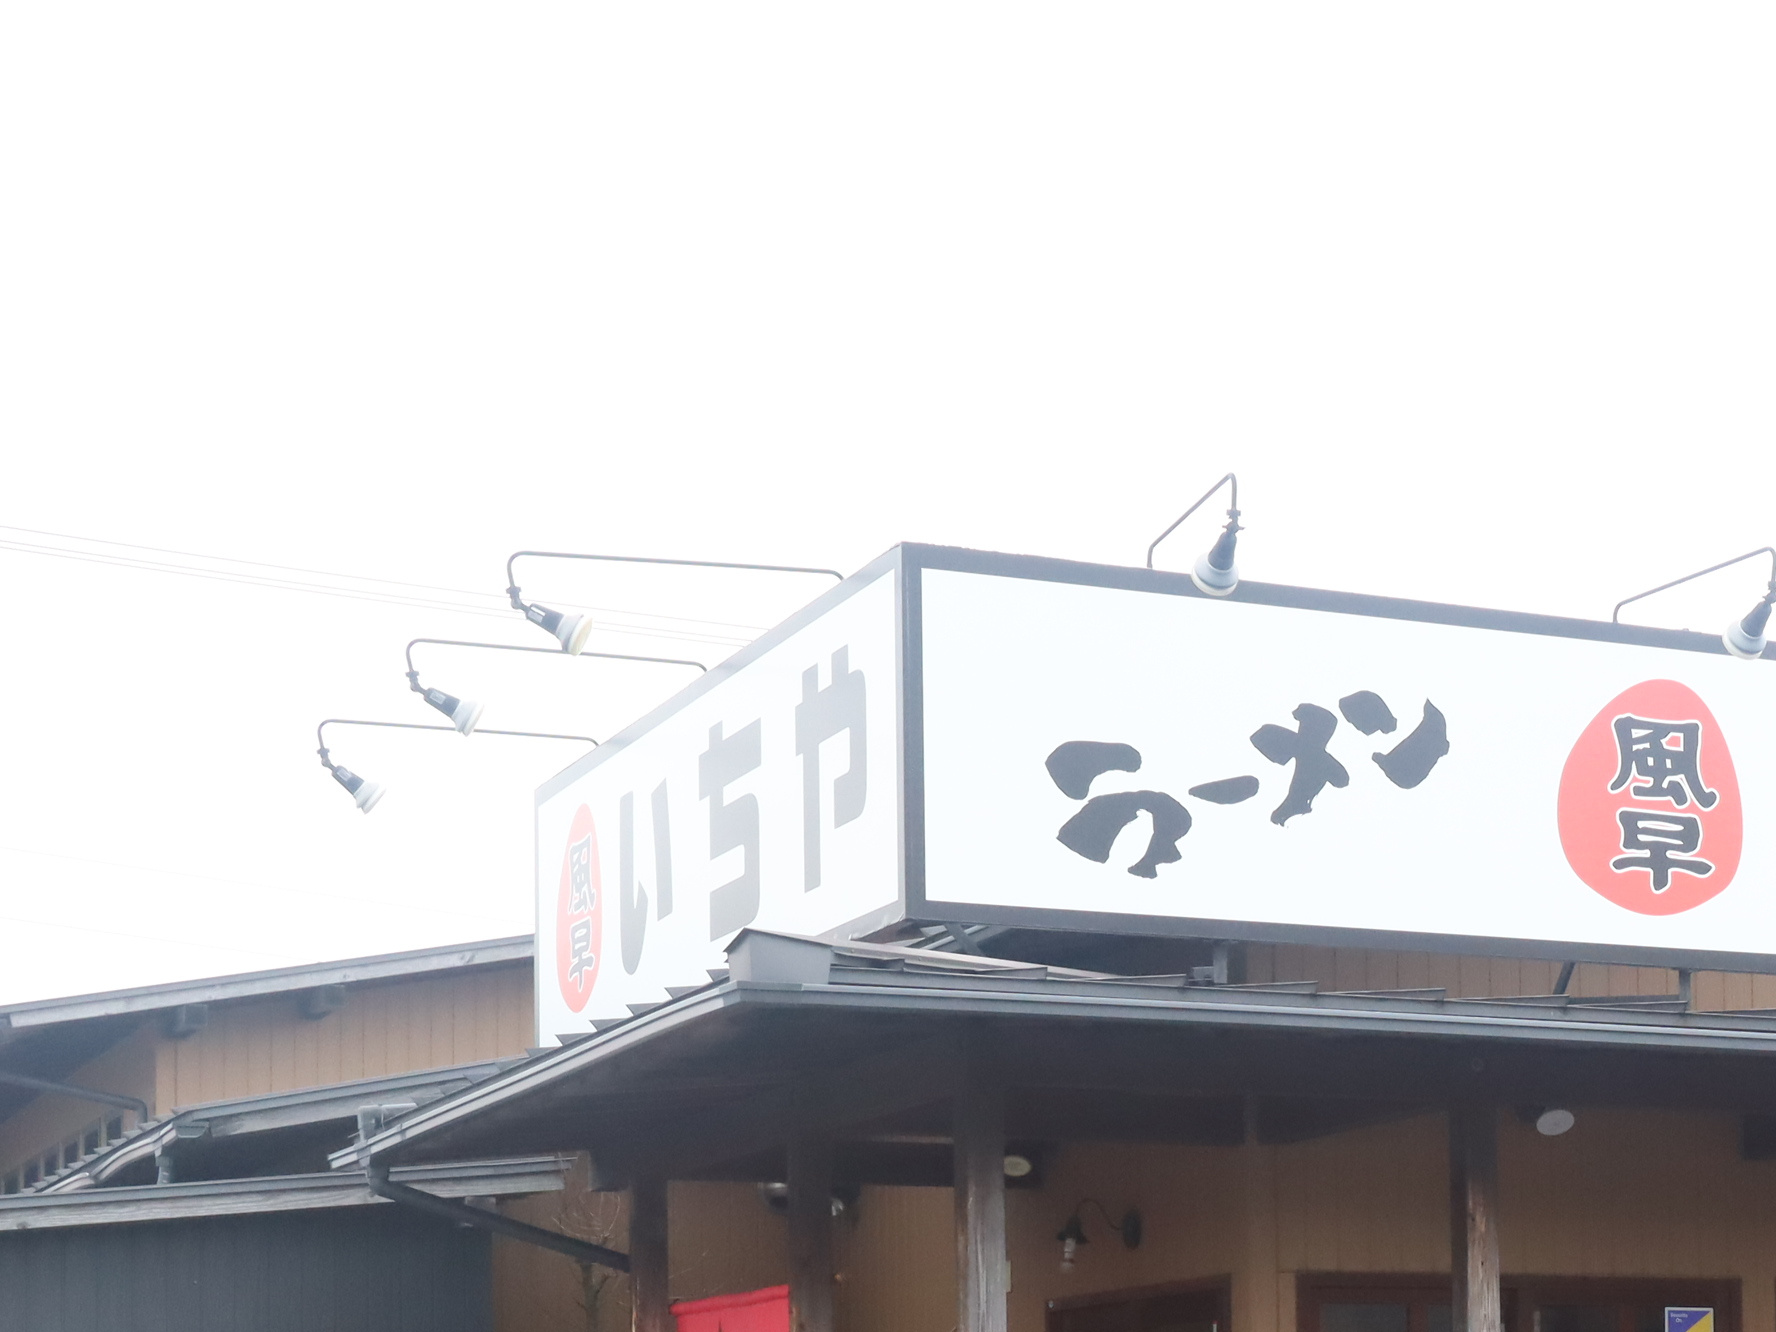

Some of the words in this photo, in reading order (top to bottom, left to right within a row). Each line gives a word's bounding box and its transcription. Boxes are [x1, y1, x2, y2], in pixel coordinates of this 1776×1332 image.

[618, 643, 867, 976] いちや
[1045, 689, 1450, 879] ラーメン
[1608, 714, 1718, 894] 風早
[567, 834, 597, 990] 風早
